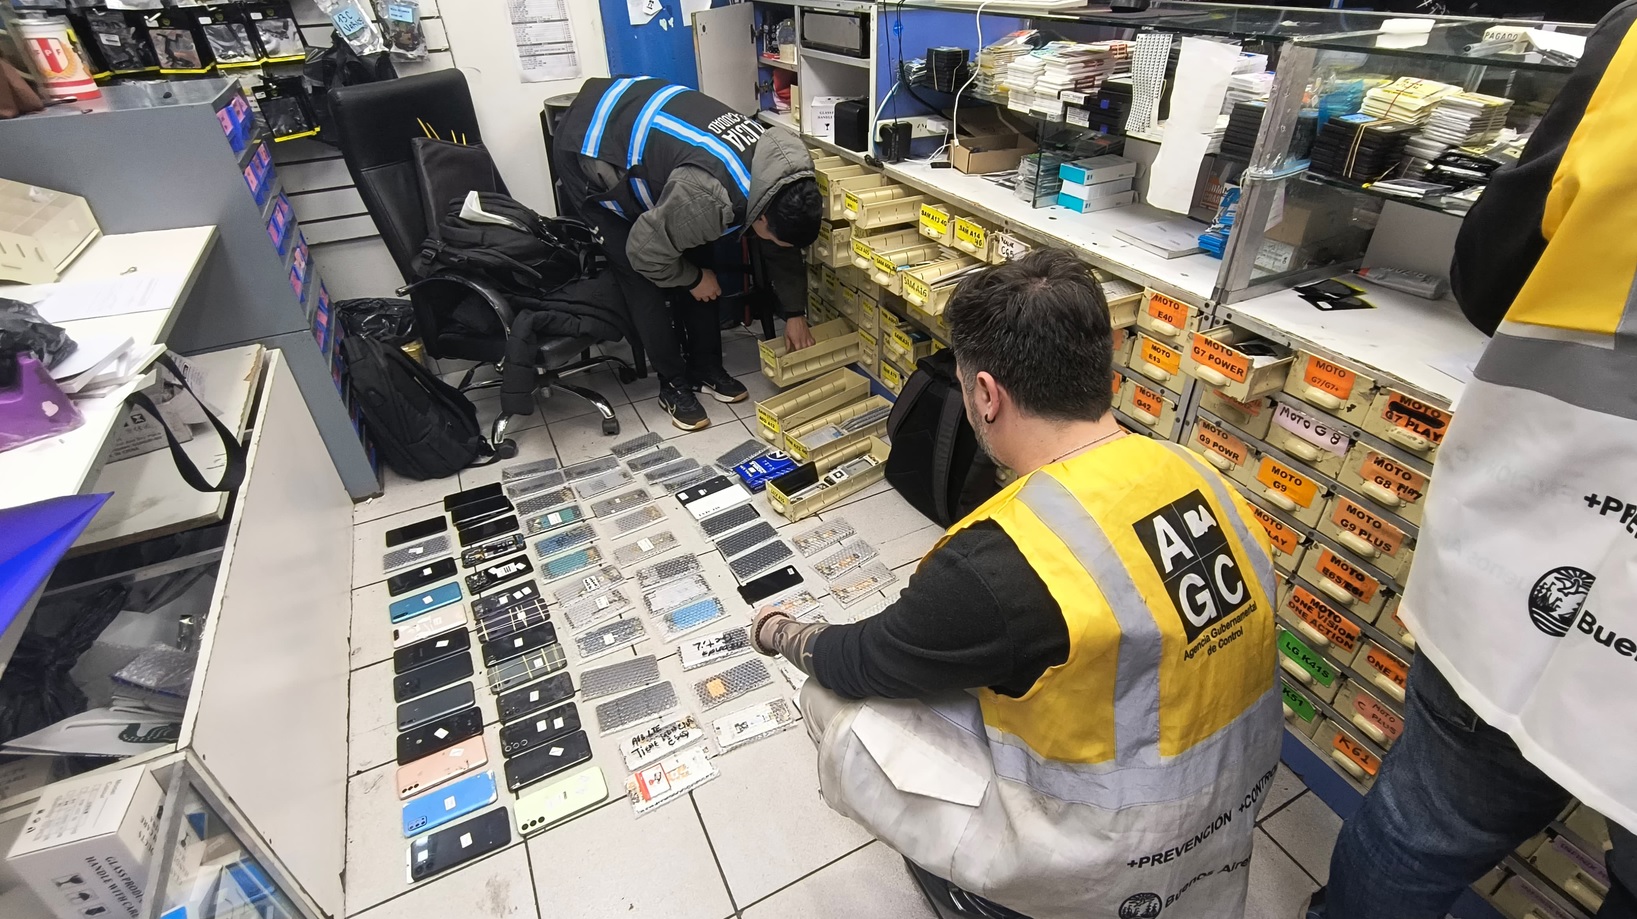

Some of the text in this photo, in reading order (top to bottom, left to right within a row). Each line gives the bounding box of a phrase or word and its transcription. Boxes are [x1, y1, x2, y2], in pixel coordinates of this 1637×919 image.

[721, 120, 766, 152] LICIA
[921, 210, 931, 219] SAM
[958, 225, 969, 235] SAM
[1157, 311, 1174, 322] E40
[1148, 354, 1160, 364] E13
[1151, 344, 1171, 358] MOTO
[1204, 338, 1233, 356] MOTO
[1194, 346, 1244, 377] G7 POWER
[1316, 361, 1346, 378] MOTO
[1139, 388, 1162, 403] MOTO
[1311, 376, 1339, 392] G7/G7+
[1136, 400, 1152, 412] G42
[1399, 396, 1442, 418] MOTO
[1202, 422, 1229, 440] MOTO
[1280, 406, 1342, 445] MOTO G 8
[1385, 411, 1402, 422] G7
[1406, 418, 1442, 443] PLAY
[1199, 434, 1240, 461] G9 POWR
[1271, 466, 1302, 486] MOTO
[1373, 456, 1412, 480] MOTO
[1272, 480, 1288, 492] G9
[1374, 476, 1392, 489] G8
[1254, 508, 1282, 530] MOTO
[1346, 504, 1382, 530] MOTO
[1152, 514, 1194, 574] A
[1340, 518, 1392, 552] G9 PLUS
[1330, 555, 1366, 582] MOTO
[1178, 553, 1244, 628] G C
[1292, 594, 1356, 642] ONE VISION
[1310, 598, 1342, 624] MOTO
[1183, 600, 1258, 662] Agencia Gubernamental
[1288, 600, 1354, 650] ONE ACTION
[1576, 610, 1637, 662] Bue
[1206, 626, 1244, 656] de Control
[1285, 642, 1330, 678] LG K41S
[1367, 655, 1392, 676] ONE
[1282, 687, 1304, 707] K51
[1371, 714, 1397, 736] PLUS
[1372, 703, 1396, 724] MOTO
[1338, 736, 1370, 765] K61
[1127, 809, 1233, 868] +PREVENCIÓN
[85, 856, 113, 883] HANDLE
[108, 883, 128, 902] WITH
[105, 856, 128, 878] GLASS
[1165, 870, 1214, 908] Buenos
